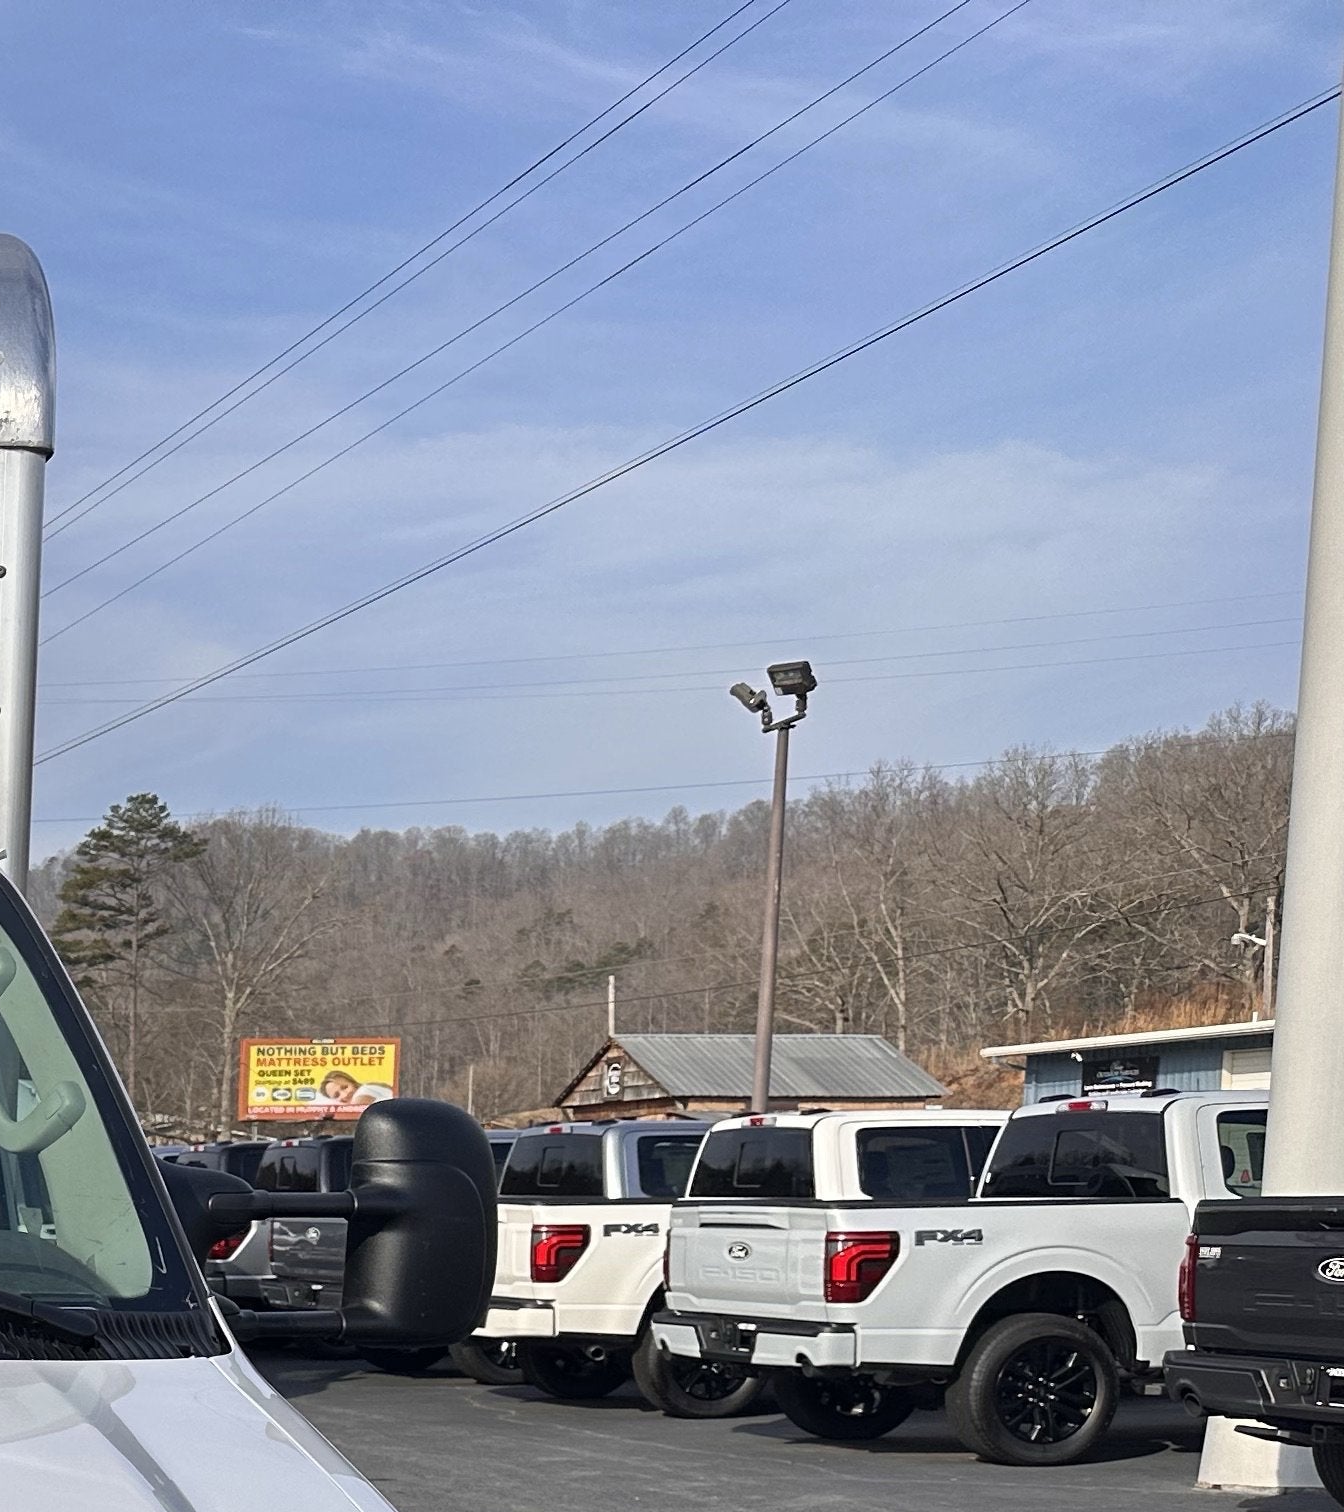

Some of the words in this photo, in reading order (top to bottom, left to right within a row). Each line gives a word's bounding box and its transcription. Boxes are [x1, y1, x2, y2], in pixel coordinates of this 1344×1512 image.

[256, 1046, 317, 1057] NOTHING
[320, 1046, 347, 1056] BUT
[351, 1045, 386, 1056] BEDS
[256, 1057, 328, 1067] MATTRESS
[332, 1056, 385, 1066] OUTLET
[257, 1069, 291, 1078] QUEEN
[293, 1069, 312, 1077] SET
[248, 1106, 285, 1114] LOCATED
[603, 1223, 659, 1237] FX4
[915, 1228, 983, 1246] FX4
